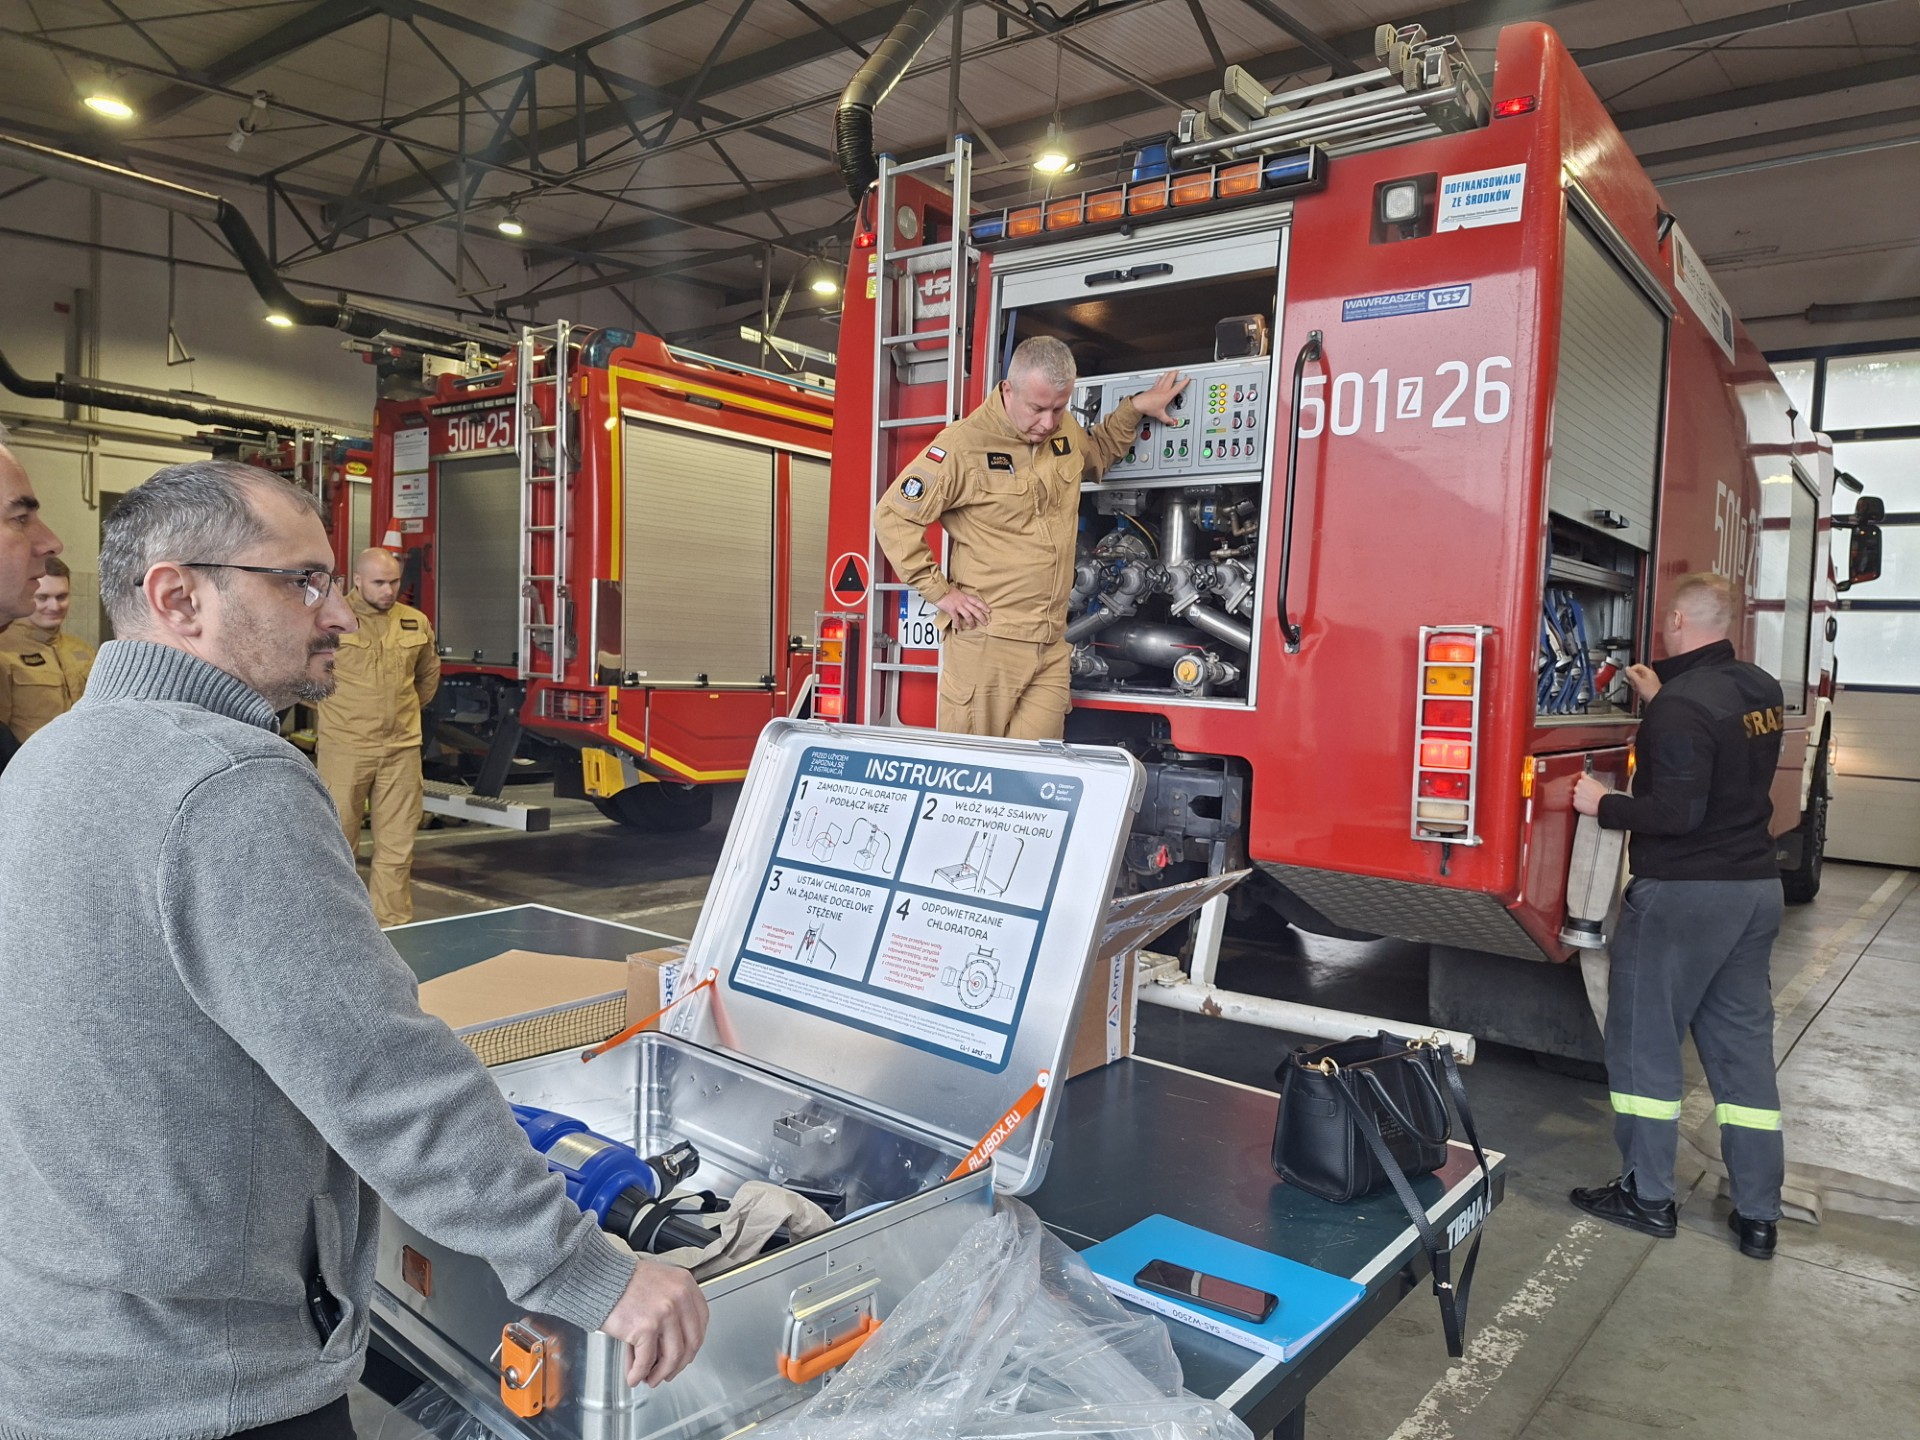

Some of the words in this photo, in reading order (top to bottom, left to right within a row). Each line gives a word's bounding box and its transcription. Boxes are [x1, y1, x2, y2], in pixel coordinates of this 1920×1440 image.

[1445, 173, 1521, 194] DOFINANSOWANO
[1452, 196, 1462, 208] ZE
[1465, 189, 1511, 206] ŚRODKÓW
[1345, 291, 1426, 309] WAWRZASZEK
[811, 758, 837, 768] ZAPOZNAJ
[812, 751, 828, 759] PRZED
[865, 758, 992, 795] INSTRUKCJA
[800, 780, 808, 800] 1
[817, 782, 858, 795] ZAMONTUJ
[860, 788, 907, 802] CHLORATOR
[830, 797, 866, 810] PODŁĄCZ
[867, 803, 890, 814] WĘŻE
[922, 798, 937, 820] 2
[955, 800, 982, 813] WŁÓŻ
[984, 804, 1005, 818] WĄŻ
[1007, 809, 1047, 822] SSAWNY
[941, 813, 955, 824] DO
[957, 816, 1011, 832] ROZTWORU
[1013, 824, 1054, 839] CHLORU
[770, 870, 783, 891] 3
[797, 875, 823, 888] USTAW
[823, 881, 871, 898] CHLORATOR
[786, 887, 797, 896] NA
[798, 888, 829, 903] ŻĄDANE
[829, 896, 874, 914] DOCELOWE
[896, 898, 911, 921] 4
[806, 905, 843, 921] STĘŻENIE
[921, 902, 1004, 928] ODPOWIETRZANIE
[926, 918, 988, 940] CHLORATORA
[967, 1110, 1021, 1171] ALUBOX.EU
[1446, 1194, 1491, 1250] TIBHA
[1172, 1309, 1221, 1334] SAS-W2500
